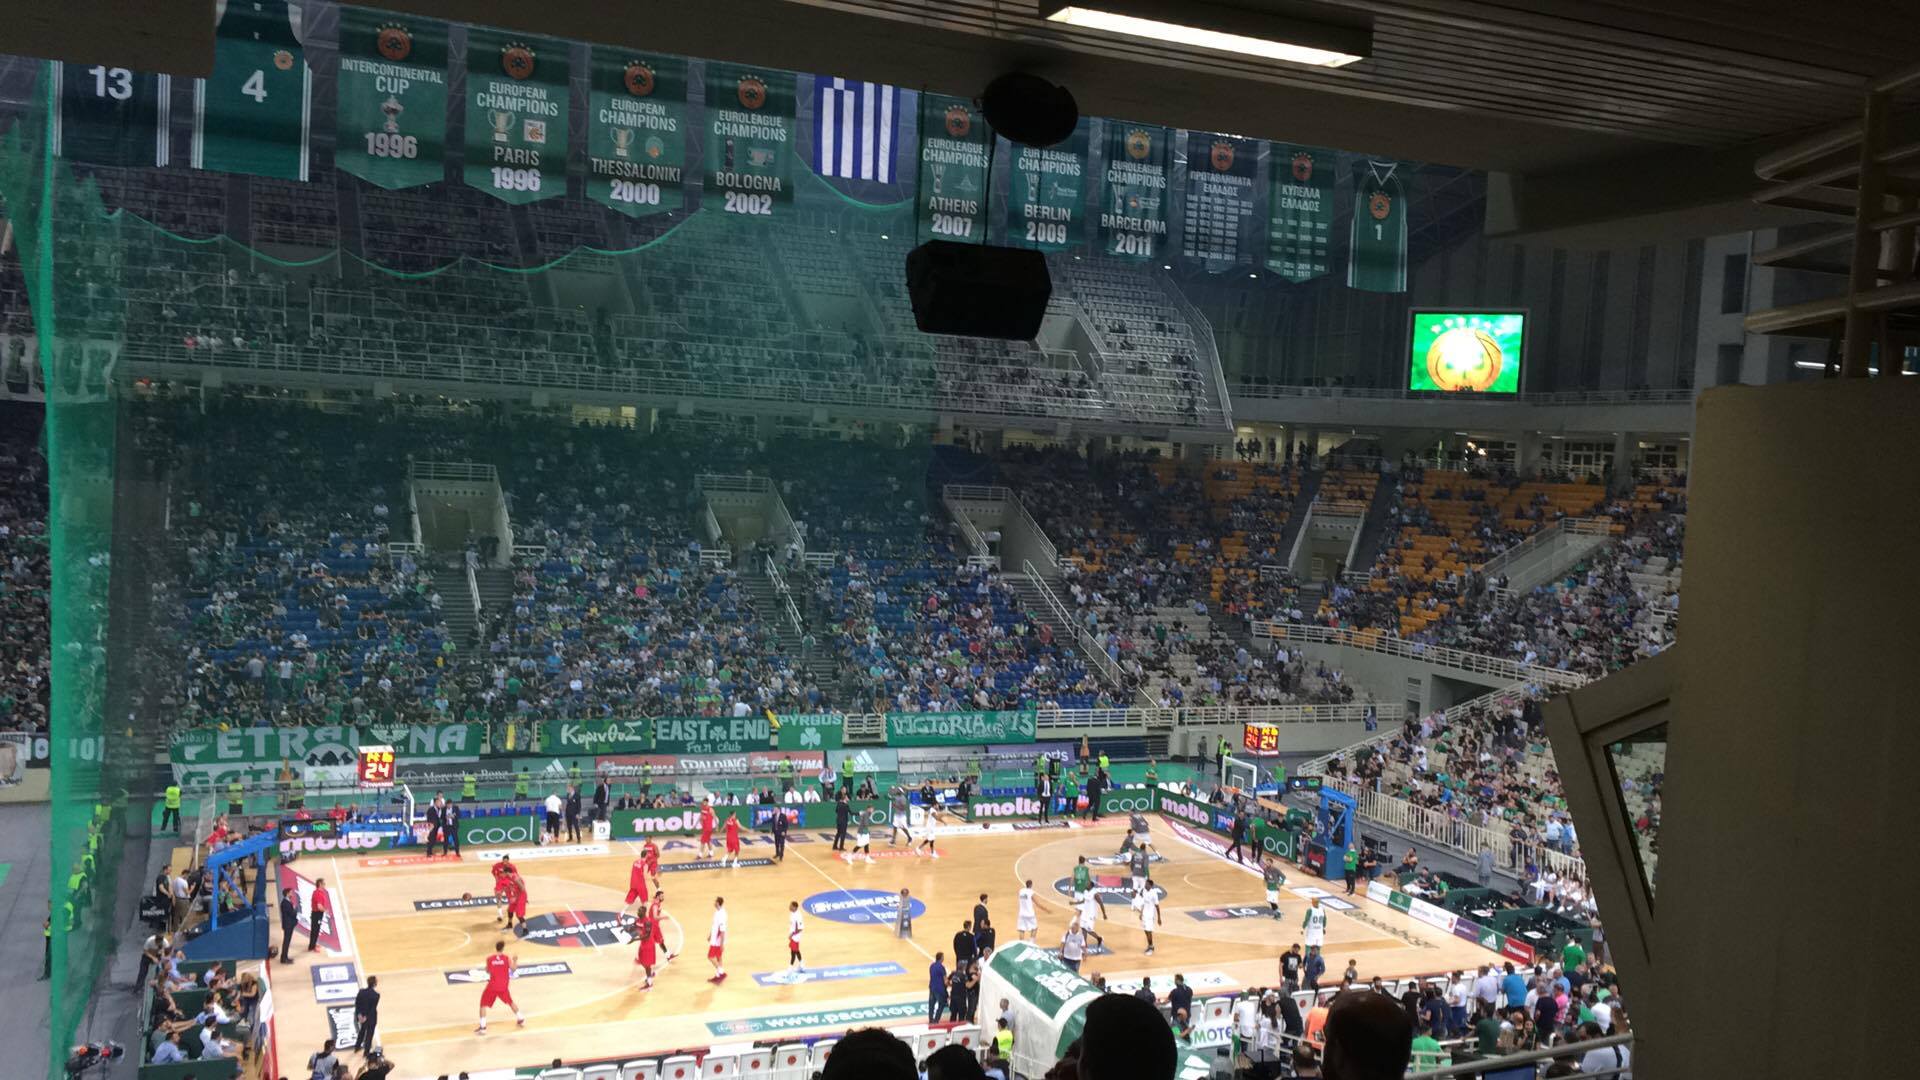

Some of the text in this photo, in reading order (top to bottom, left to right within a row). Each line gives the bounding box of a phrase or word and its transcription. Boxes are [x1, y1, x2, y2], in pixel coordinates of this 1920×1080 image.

[341, 57, 444, 84] INTERCONTINENTAL
[88, 65, 134, 101] 13
[241, 69, 268, 103] 4
[375, 76, 410, 94] CUP
[489, 81, 547, 100] EUROPEAN
[476, 93, 559, 117] CHAMPIONS
[611, 98, 666, 115] EUROPEAN
[599, 109, 677, 132] CHAMPIONS
[719, 110, 783, 127] EUROLEAGUE
[713, 122, 787, 142] CHAMPIONS
[364, 132, 418, 159] 1996
[927, 137, 984, 155] EUROLEAGUE
[494, 146, 540, 166] PARIS
[922, 149, 989, 169] CHAMPIONS
[591, 158, 681, 183] THESSALONIKI
[1018, 157, 1081, 176] CHAMPIONS
[1111, 160, 1163, 175] EUROLEAGUE
[491, 167, 541, 192] 1996
[716, 171, 781, 192] BOLOGNA
[1107, 170, 1166, 189] CHAMPIONS
[609, 179, 660, 205] 2000
[724, 191, 772, 215] 2002
[928, 196, 978, 215] ATHENS
[1024, 204, 1071, 222] BERLIN
[931, 213, 972, 238] 2007
[1101, 213, 1166, 234] BARCELONA
[1375, 224, 1383, 241] 1
[1026, 224, 1067, 244] 2009
[1115, 233, 1152, 256] 2011
[657, 718, 770, 741] EAST END
[779, 714, 842, 726] PYRGOS
[1260, 736, 1276, 749] 24
[365, 762, 390, 779] 24
[680, 757, 748, 774] SPALDING
[1106, 788, 1154, 813] cool
[466, 815, 534, 845] cool
[1263, 834, 1293, 859] ool
[1228, 905, 1258, 916] LG
[1193, 1026, 1232, 1044] MOTE
